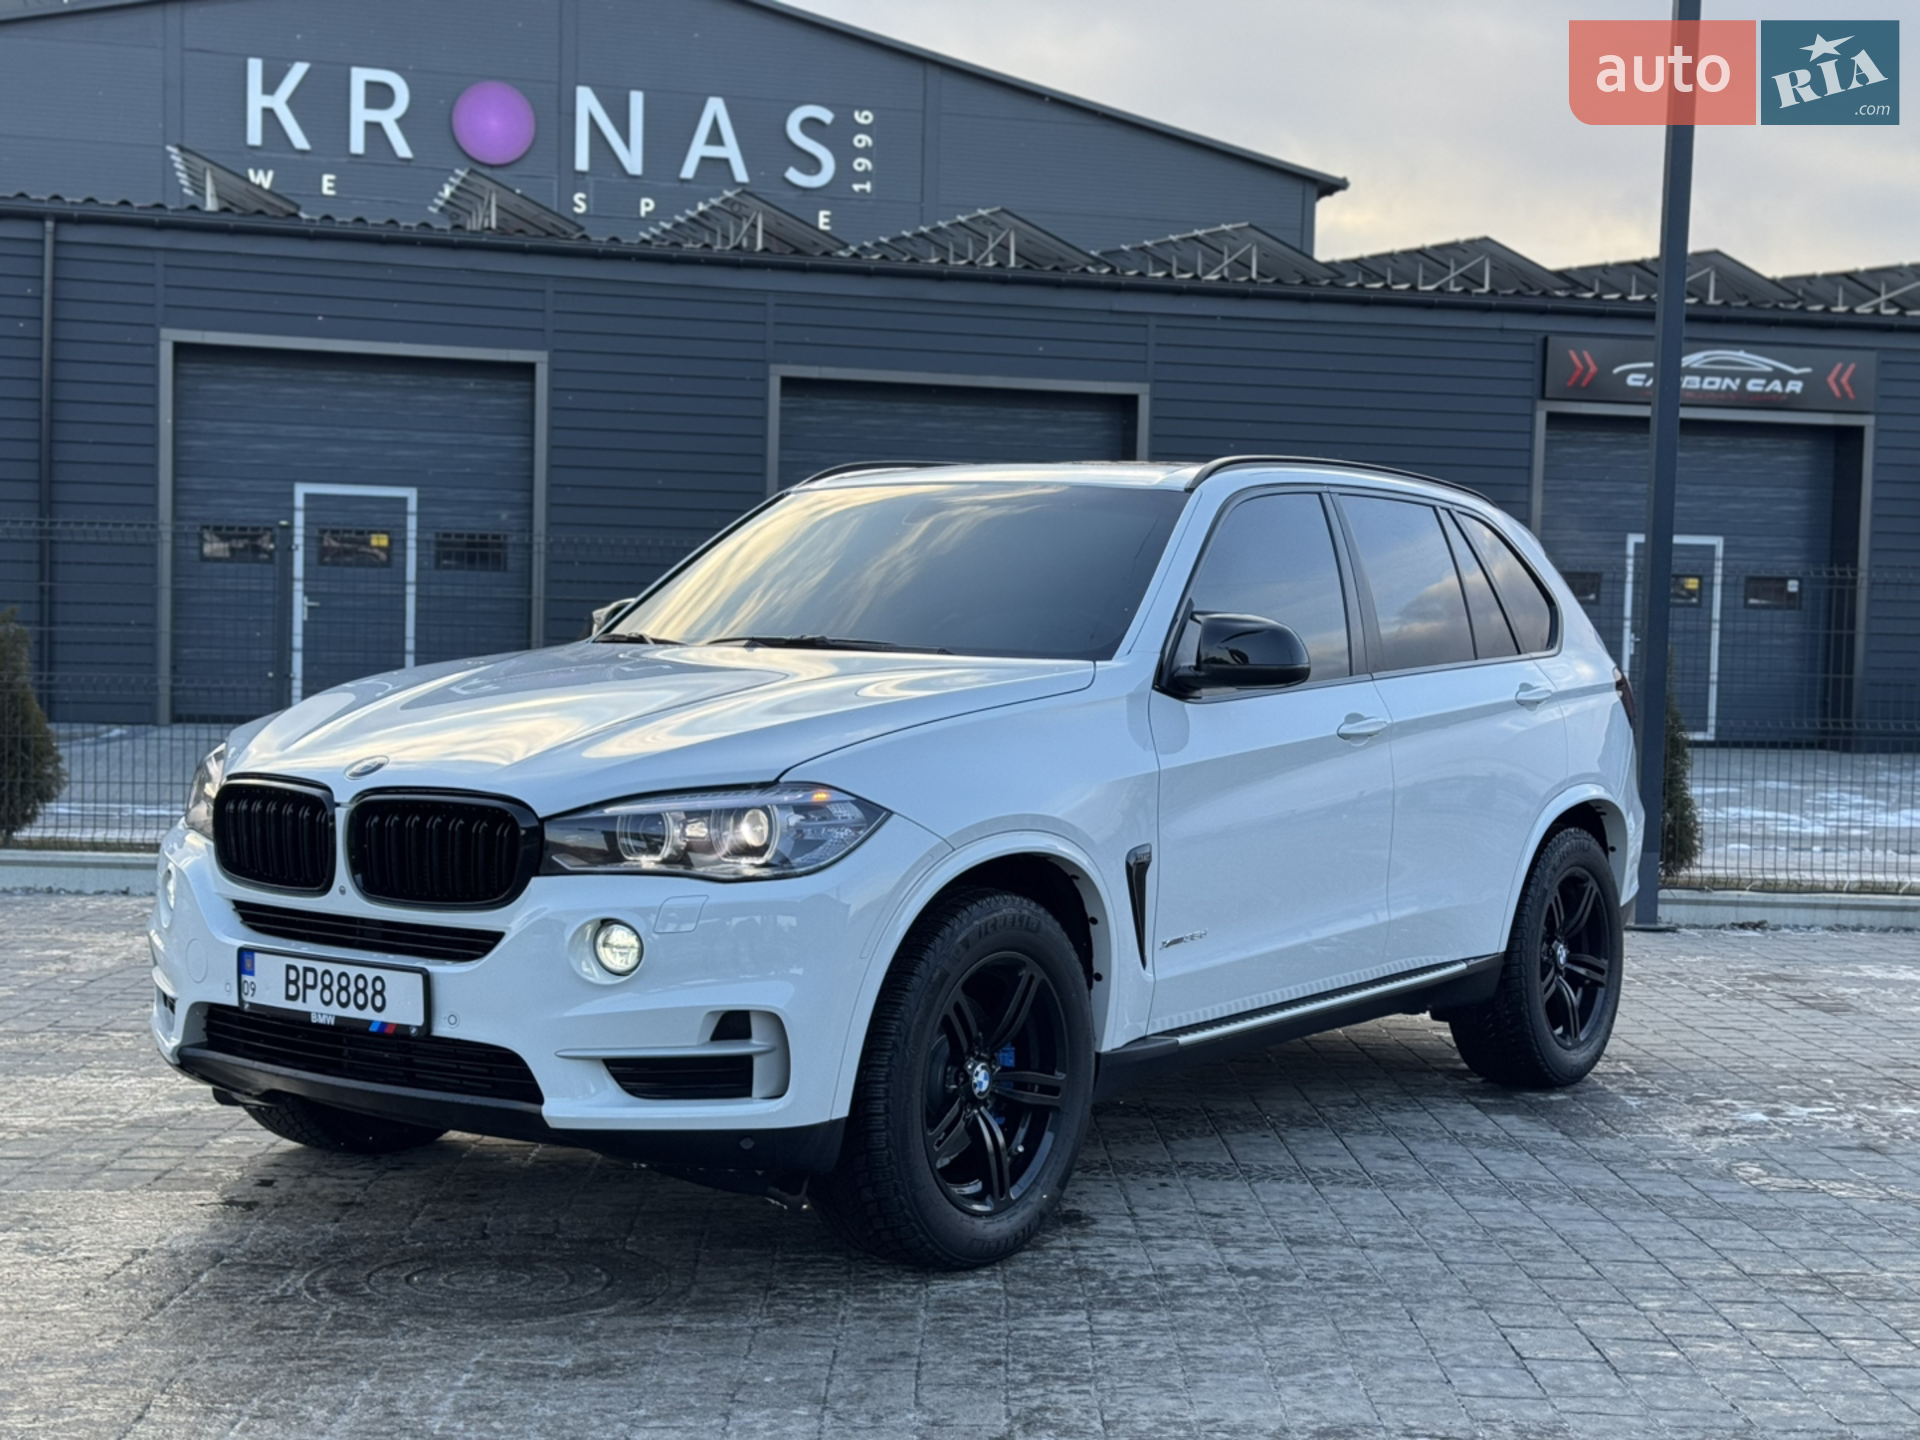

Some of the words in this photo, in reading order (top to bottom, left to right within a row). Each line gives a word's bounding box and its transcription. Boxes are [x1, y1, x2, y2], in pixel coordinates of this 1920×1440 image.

[851, 109, 875, 194] 1996
[247, 167, 337, 196] WE
[1746, 378, 1804, 395] CAR
[241, 979, 257, 998] 09
[284, 963, 387, 1013] BP8888
[310, 1012, 335, 1026] BMW
